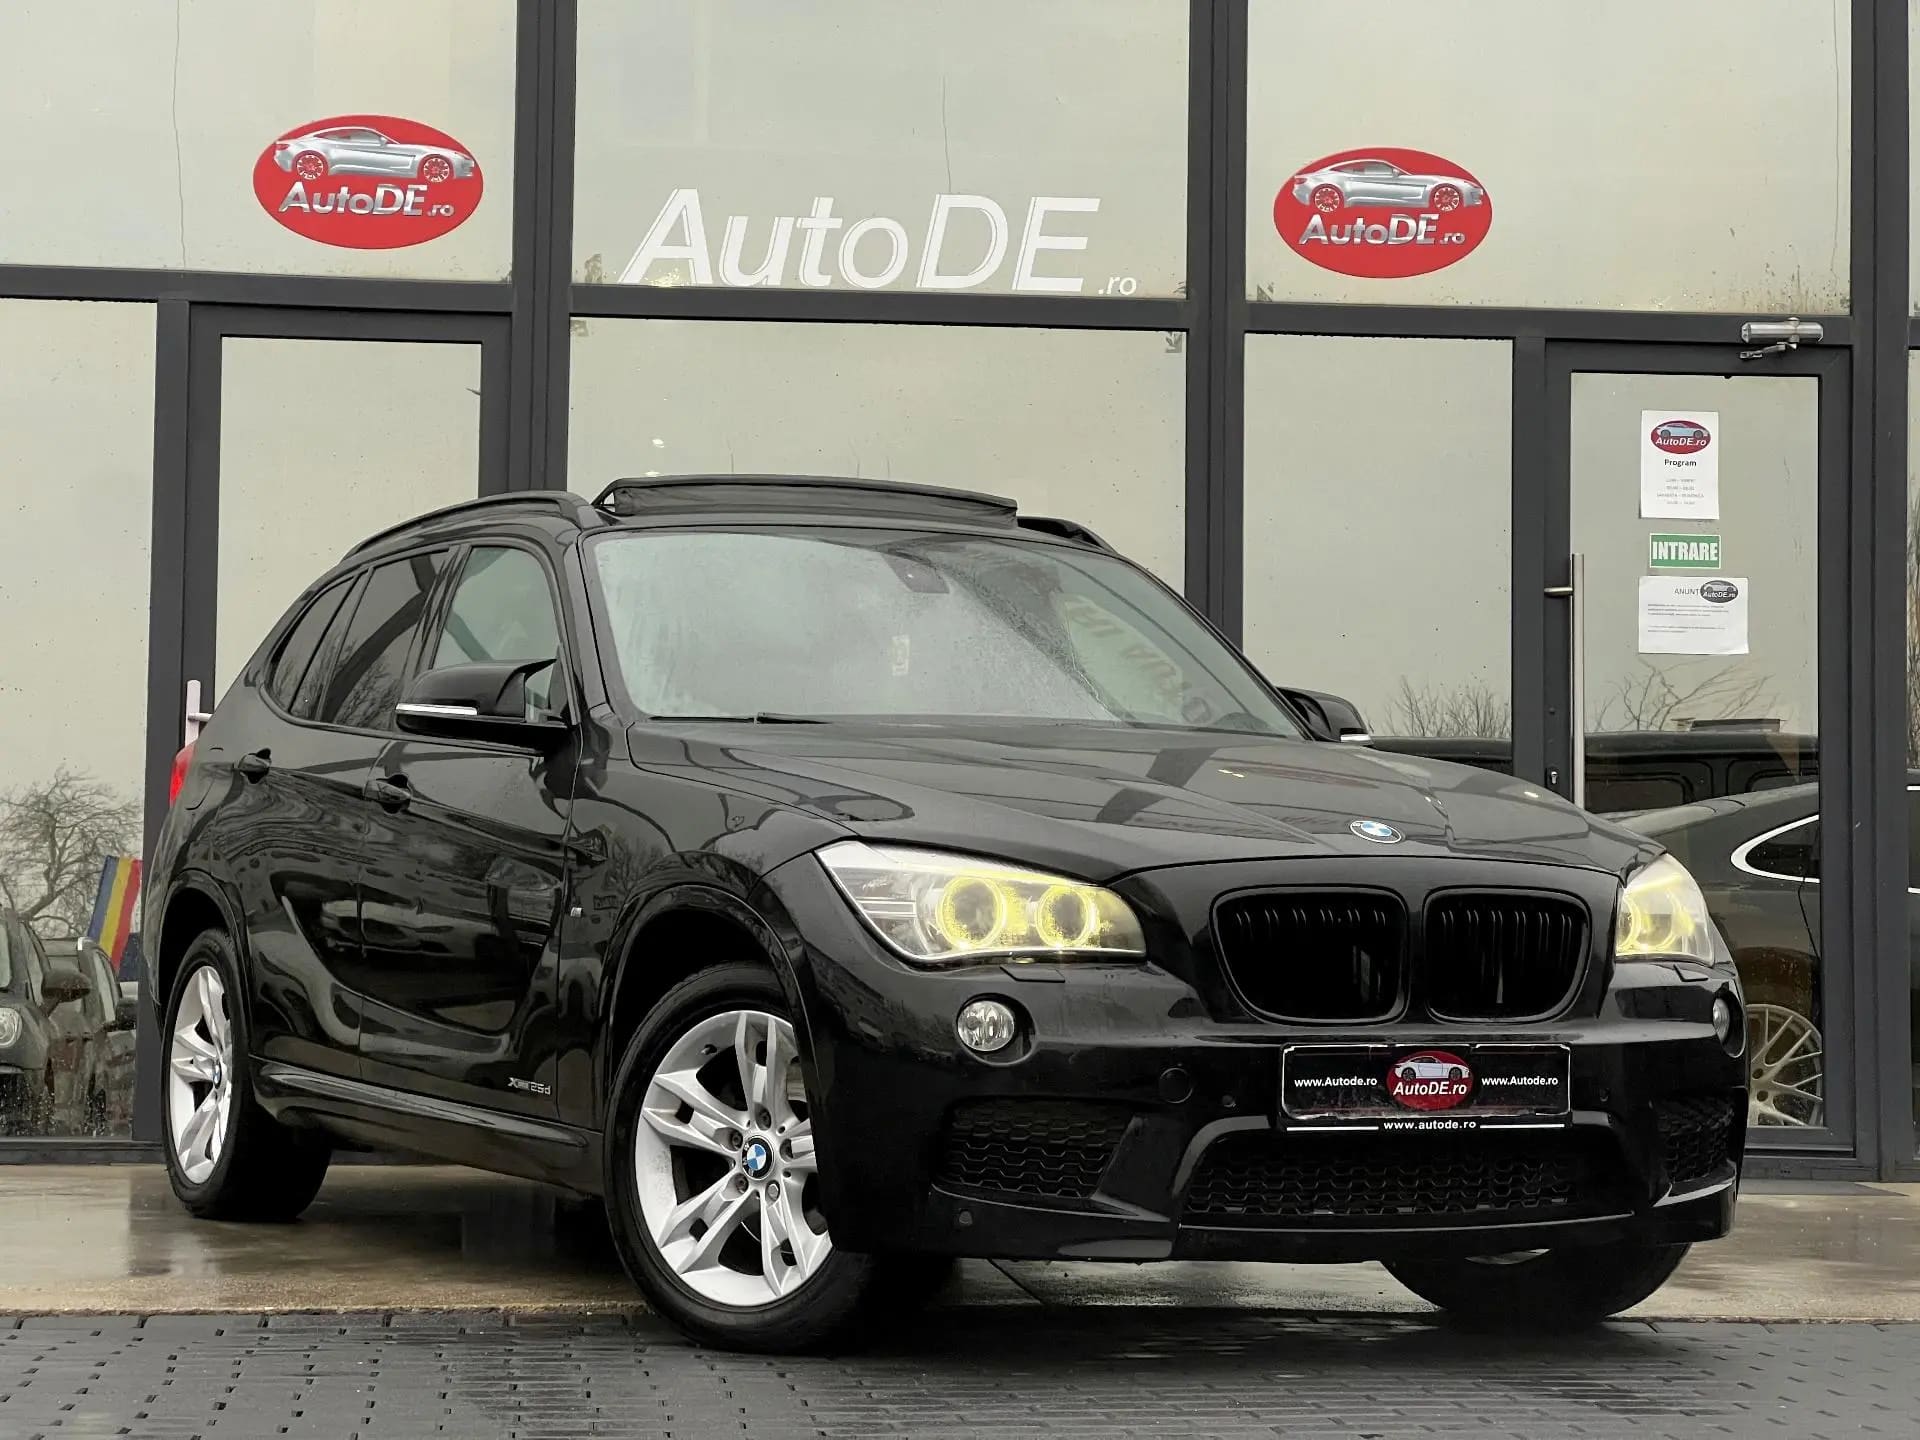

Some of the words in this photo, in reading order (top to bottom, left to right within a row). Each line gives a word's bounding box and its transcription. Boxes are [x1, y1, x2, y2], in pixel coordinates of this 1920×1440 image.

[1655, 437, 1707, 446] AutoDE.ro
[1664, 458, 1697, 467] Program
[1651, 541, 1718, 561] INTRARE
[1294, 1076, 1378, 1088] www.Autode.ro
[1482, 1075, 1559, 1087] www.Autode.ro
[1393, 1081, 1468, 1097] AutoDE.ro
[1383, 1120, 1477, 1131] www.autode.ro
